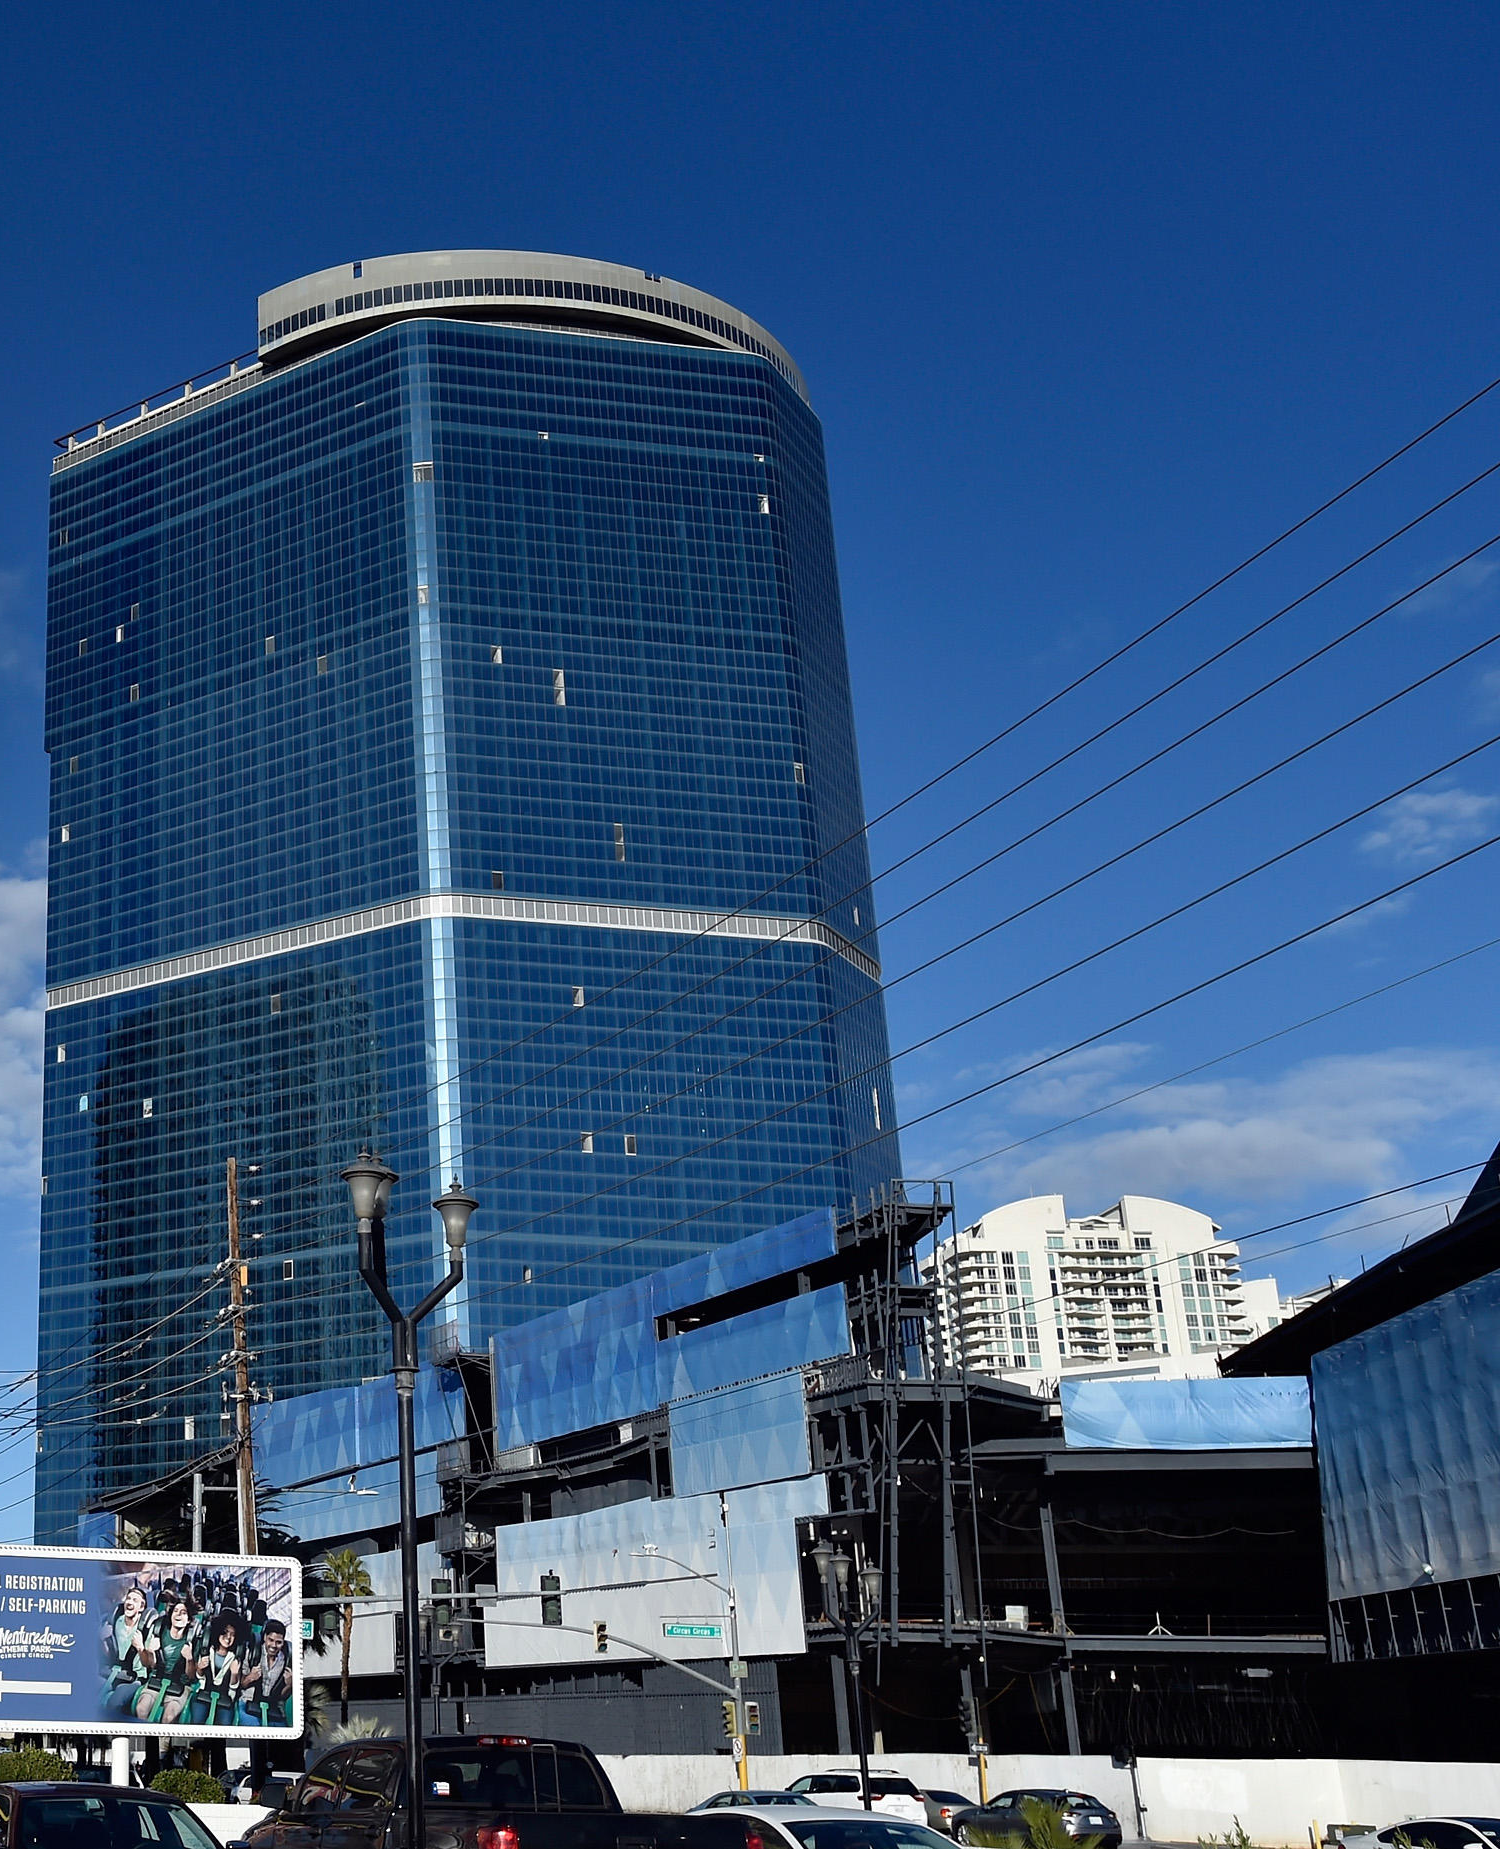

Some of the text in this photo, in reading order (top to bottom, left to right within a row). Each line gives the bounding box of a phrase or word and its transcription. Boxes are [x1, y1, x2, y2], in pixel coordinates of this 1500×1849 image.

[5, 1574, 84, 1592] REGISTRATION
[8, 1597, 87, 1615] SELF-PARKING
[2, 1645, 51, 1653] THEME PARK
